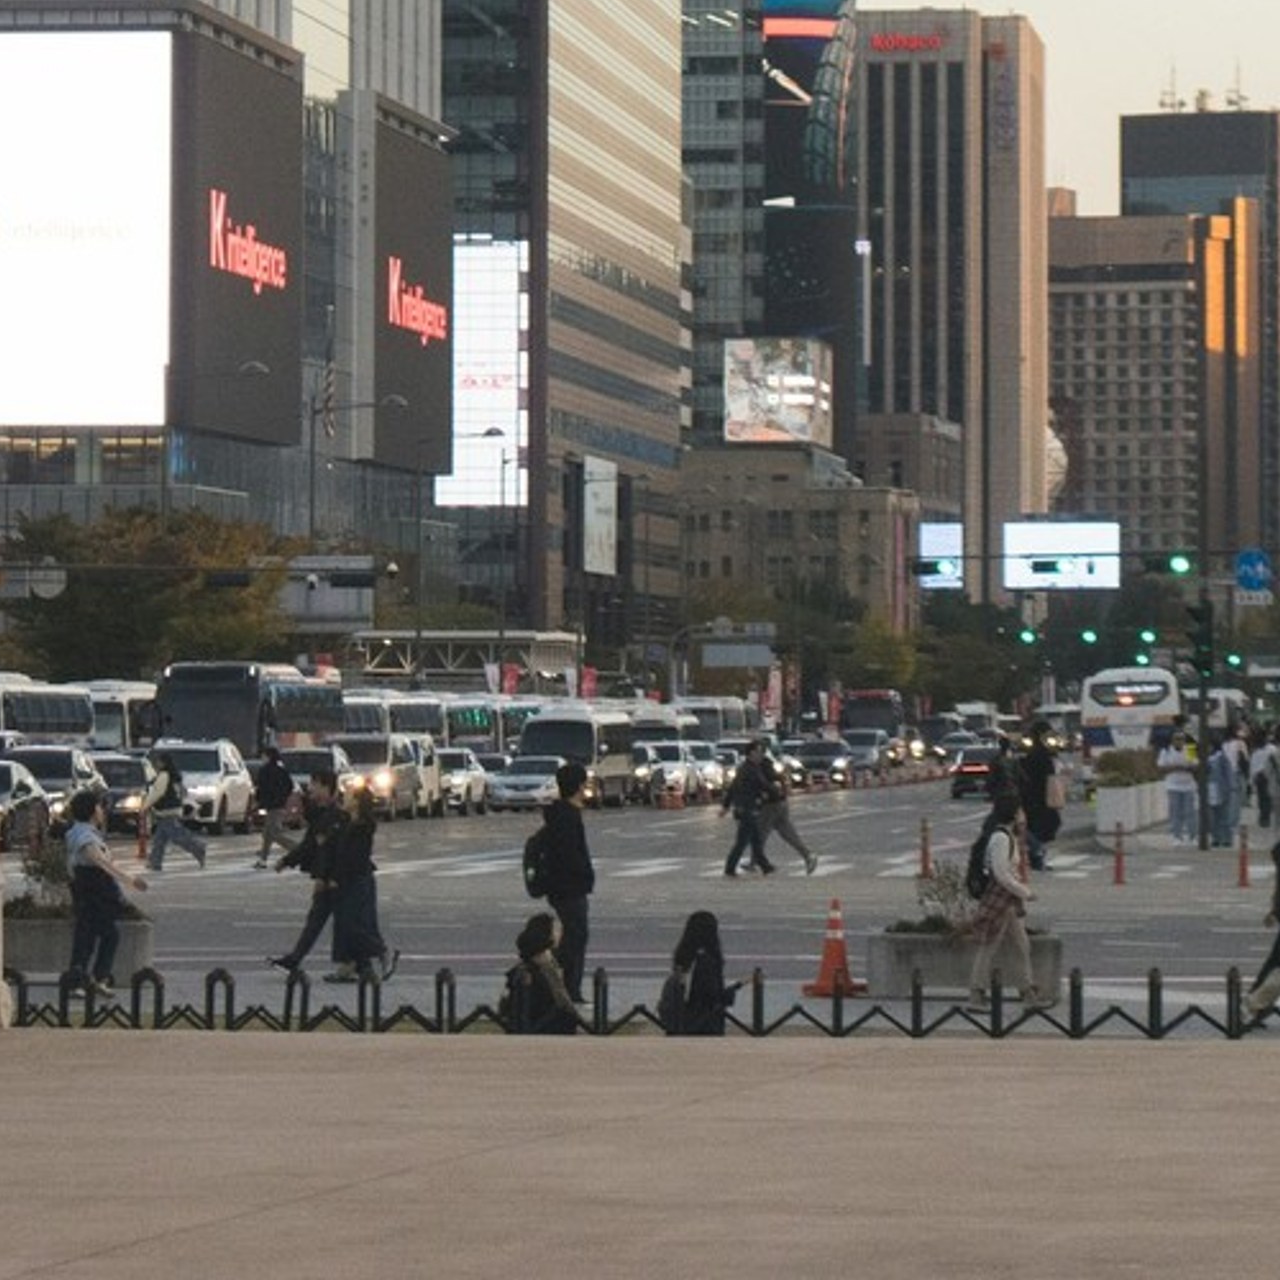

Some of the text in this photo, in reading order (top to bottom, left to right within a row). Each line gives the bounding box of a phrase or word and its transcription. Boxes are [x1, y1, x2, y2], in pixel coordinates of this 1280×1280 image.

[209, 188, 286, 296] K intelligence
[388, 255, 447, 346] K intelligence
